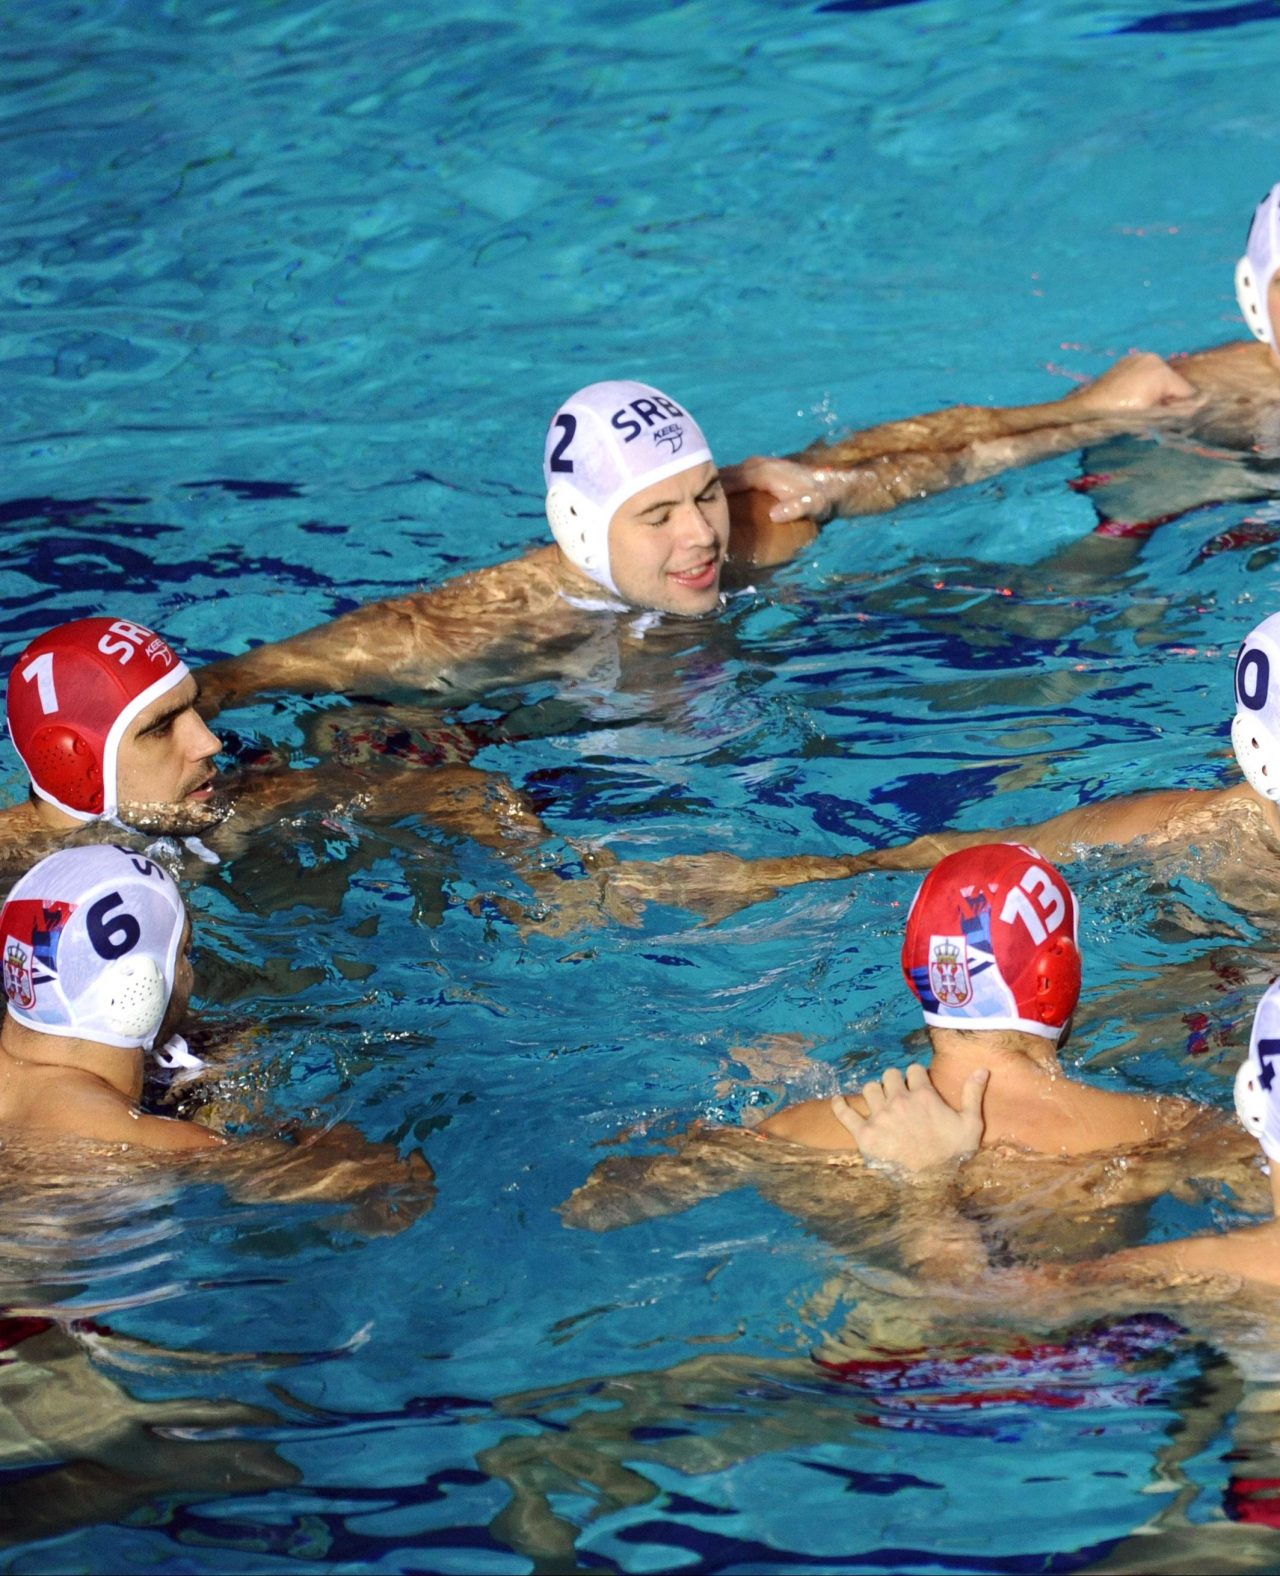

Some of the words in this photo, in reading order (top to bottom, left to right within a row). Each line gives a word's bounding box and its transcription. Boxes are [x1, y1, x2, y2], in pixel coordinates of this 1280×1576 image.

[550, 413, 577, 473] 2
[611, 398, 683, 443] SRB
[653, 423, 683, 441] KEEL
[98, 618, 155, 665] SR
[22, 652, 59, 715] 1
[86, 891, 140, 960] 6
[1000, 865, 1065, 946] 13
